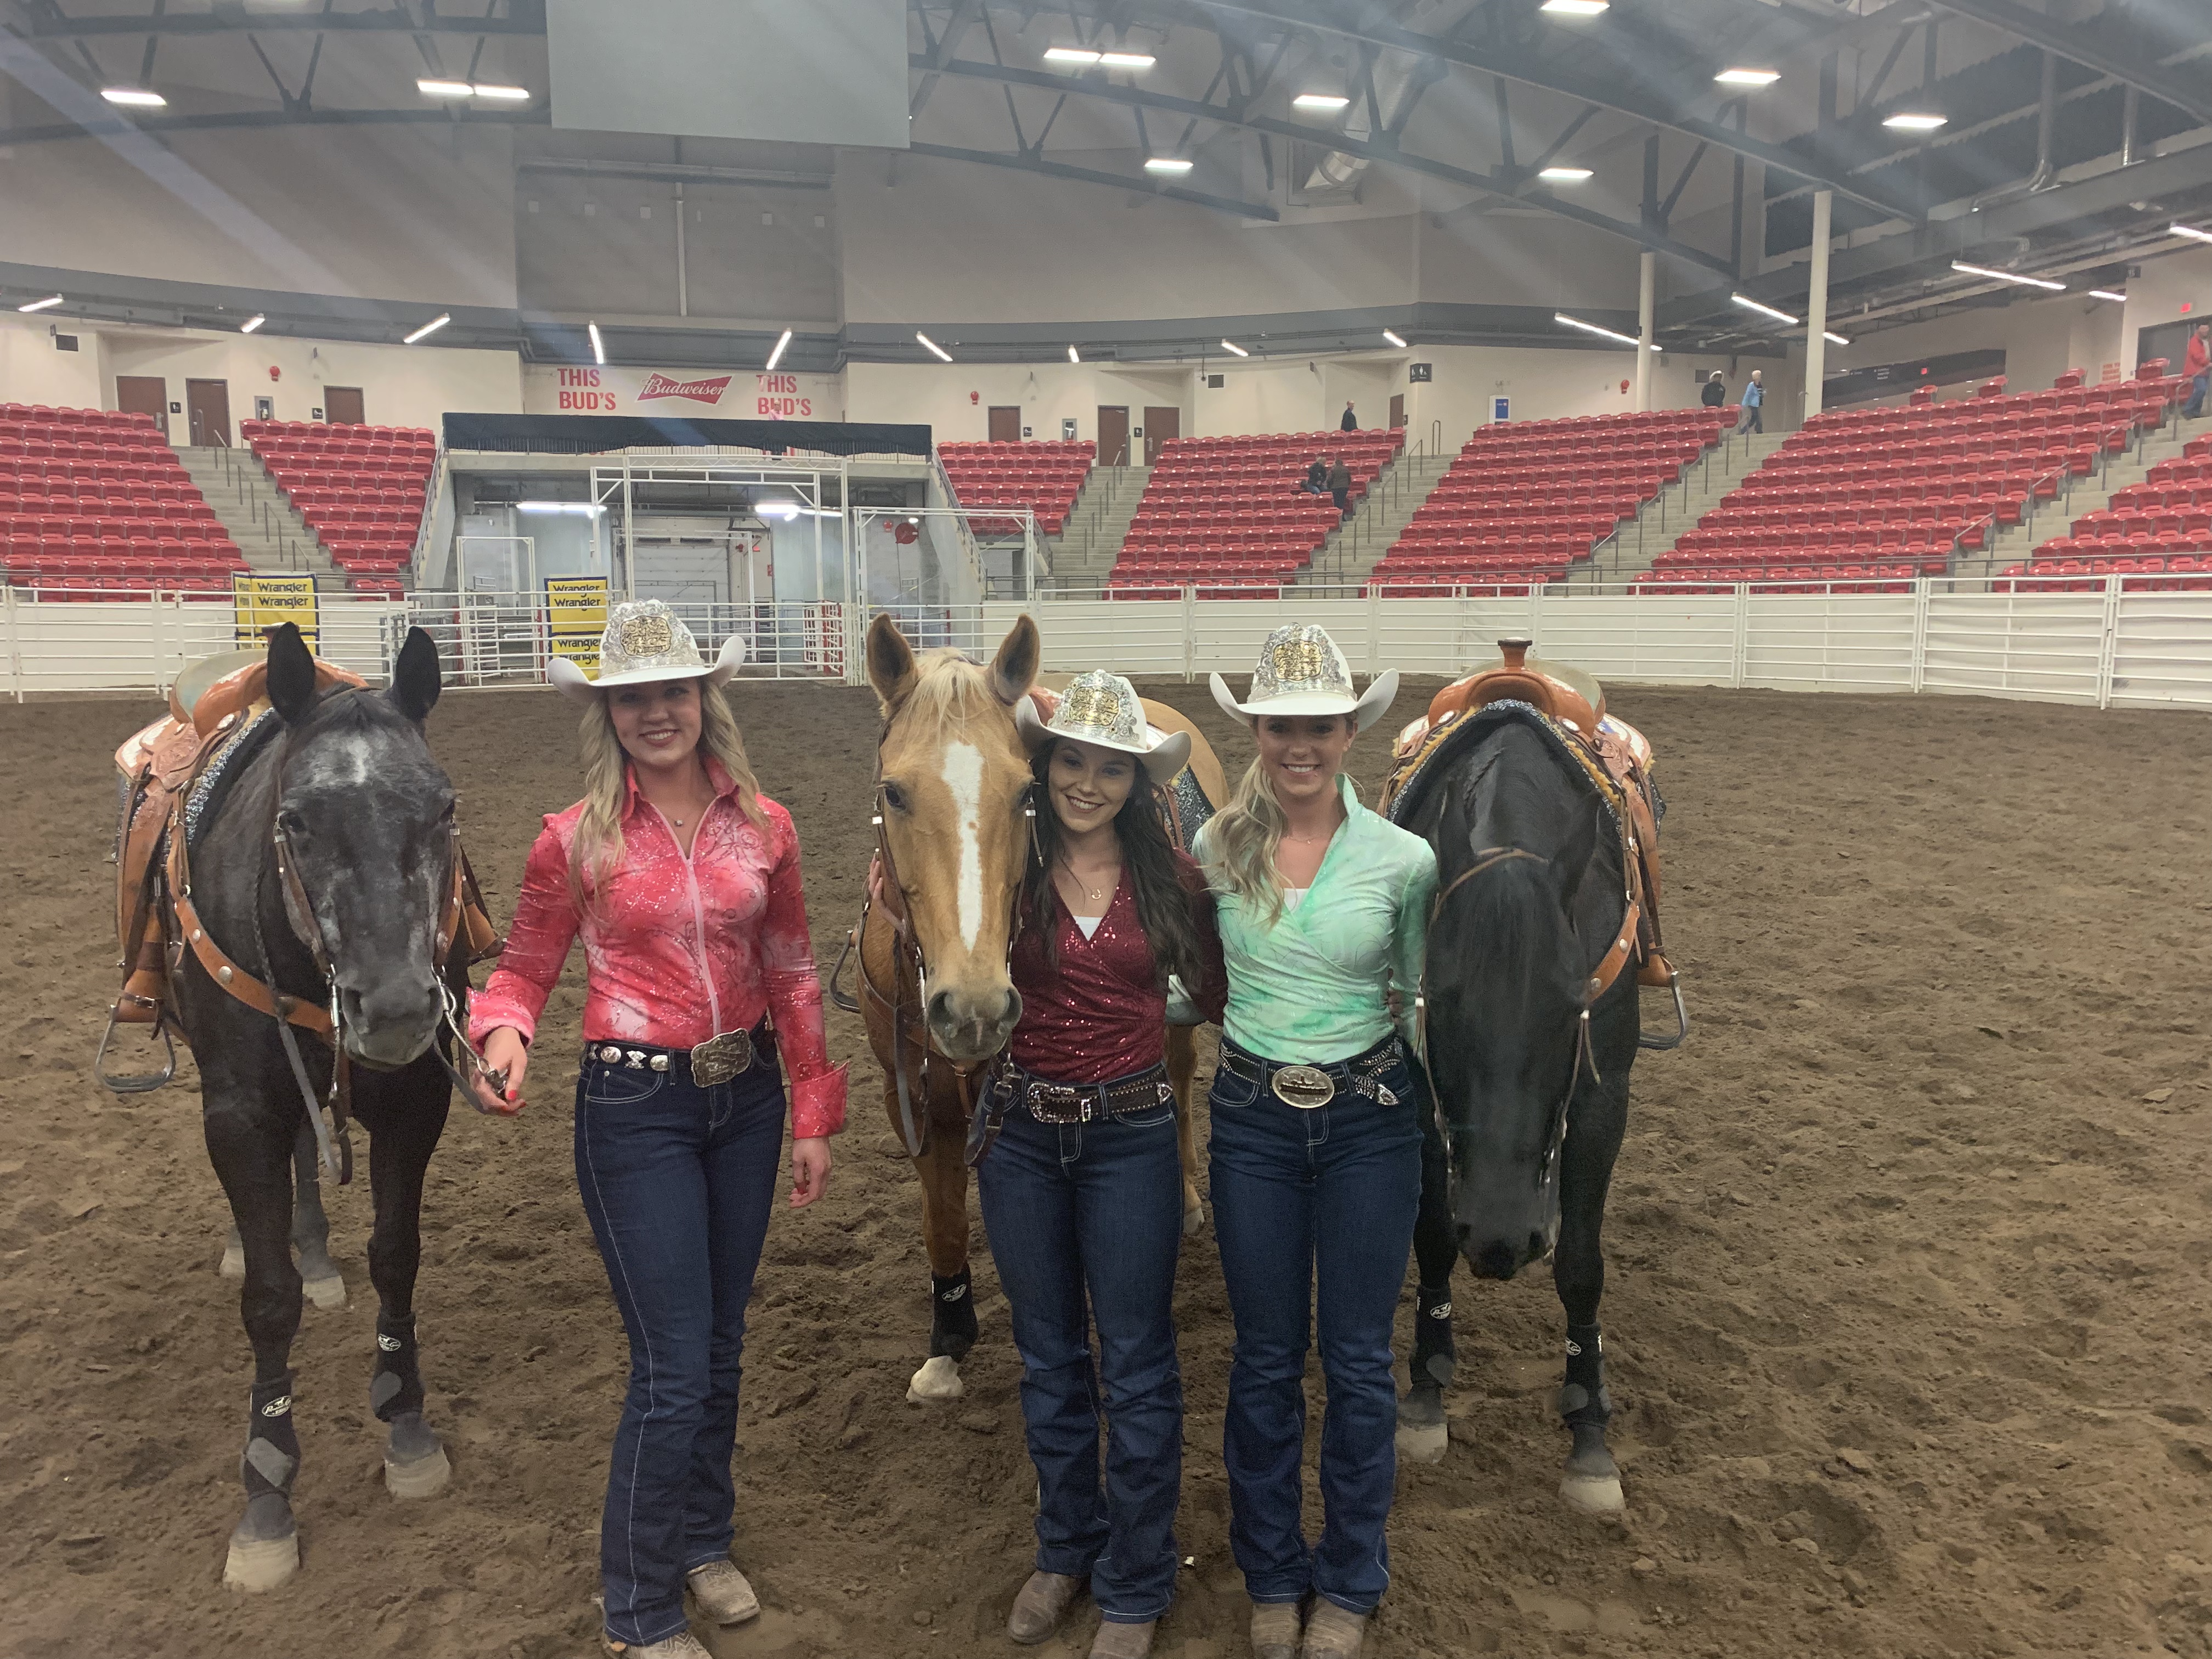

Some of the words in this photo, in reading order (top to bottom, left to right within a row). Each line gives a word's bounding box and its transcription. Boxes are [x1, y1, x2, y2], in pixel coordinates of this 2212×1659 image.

[557, 368, 600, 387] THIS
[756, 375, 797, 393] THIS
[641, 378, 727, 395] Budweiser
[559, 391, 616, 410] BUD'S
[257, 583, 307, 592] Wrangler
[553, 584, 600, 597] Wrangler
[258, 597, 308, 609] Wrangler
[554, 597, 601, 611] Wrangler
